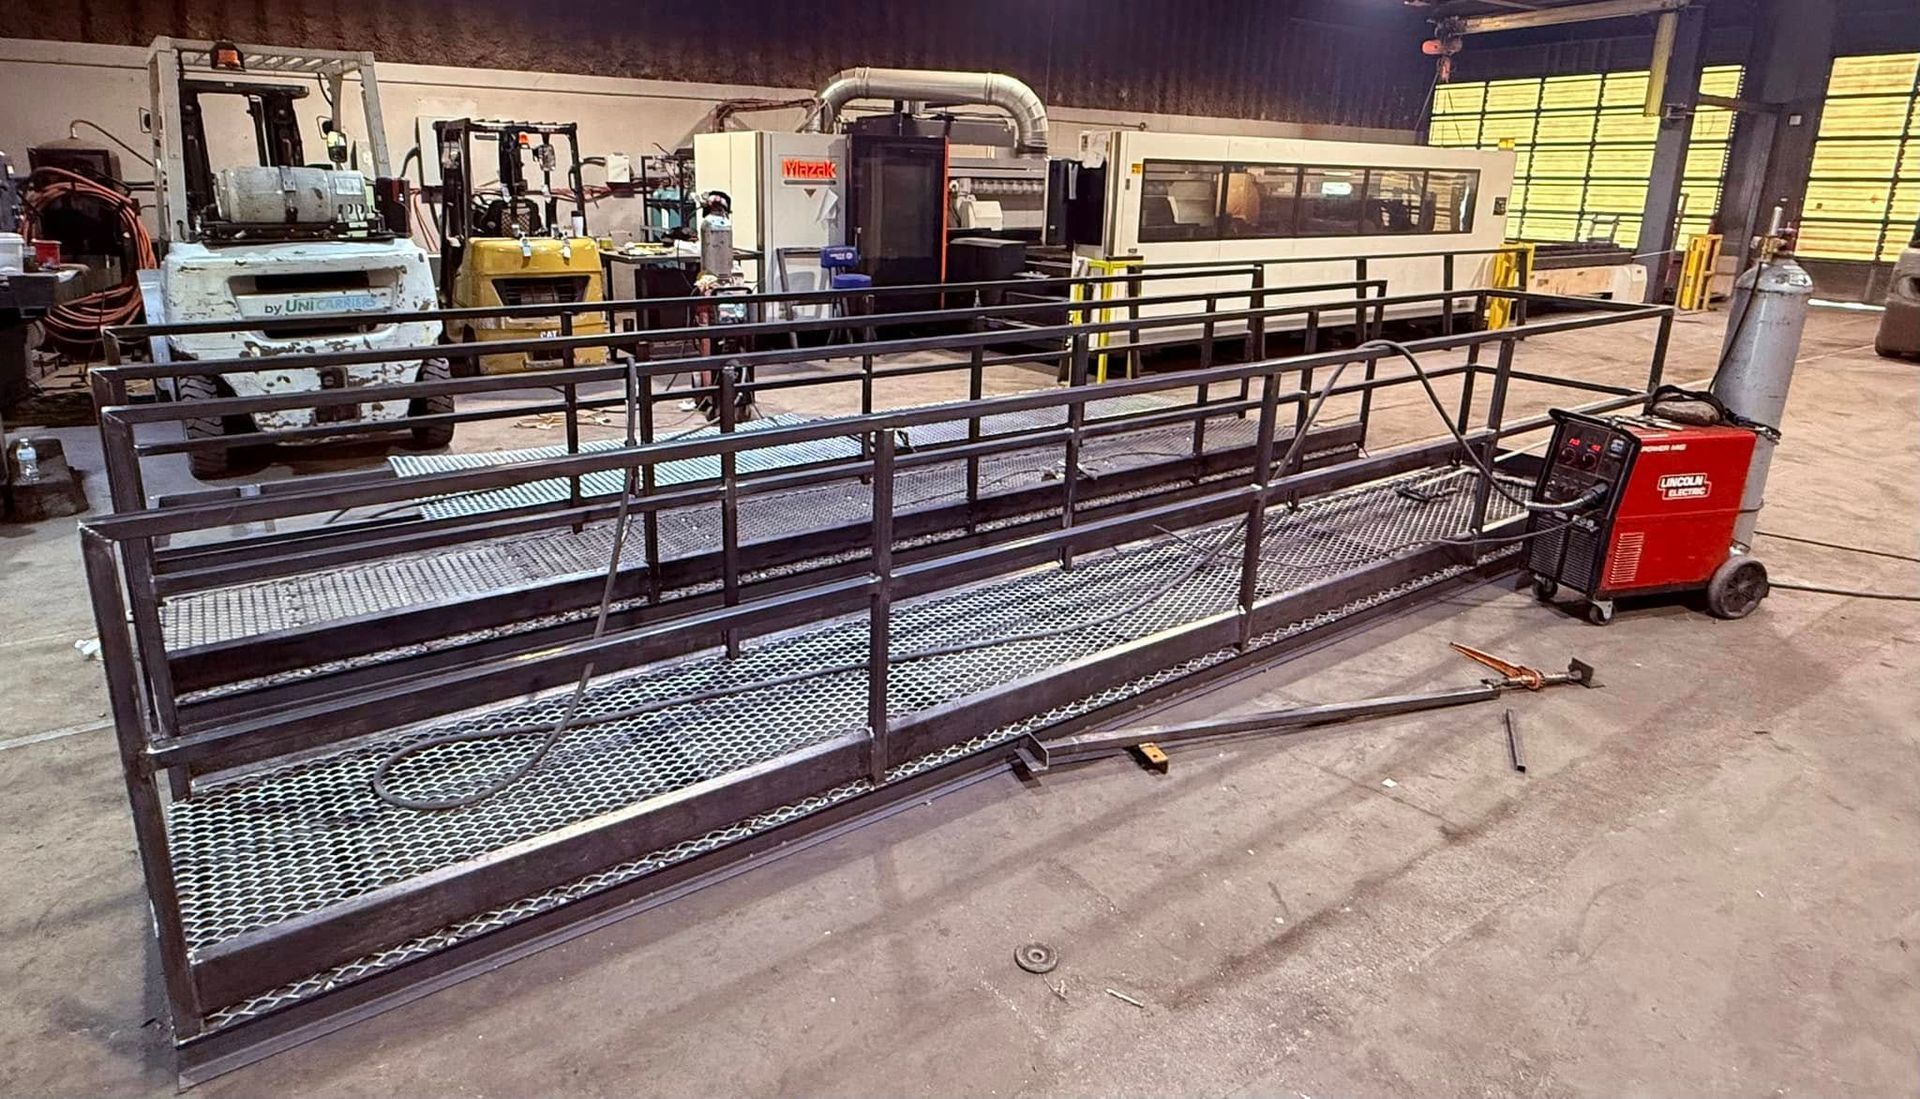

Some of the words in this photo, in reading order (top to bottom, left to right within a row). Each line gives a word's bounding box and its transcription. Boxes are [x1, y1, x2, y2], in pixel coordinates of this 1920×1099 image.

[783, 159, 837, 178] Mazak
[264, 304, 282, 315] by
[1661, 476, 1704, 488] LINCOLN
[1668, 487, 1706, 497] ELECTRIC
